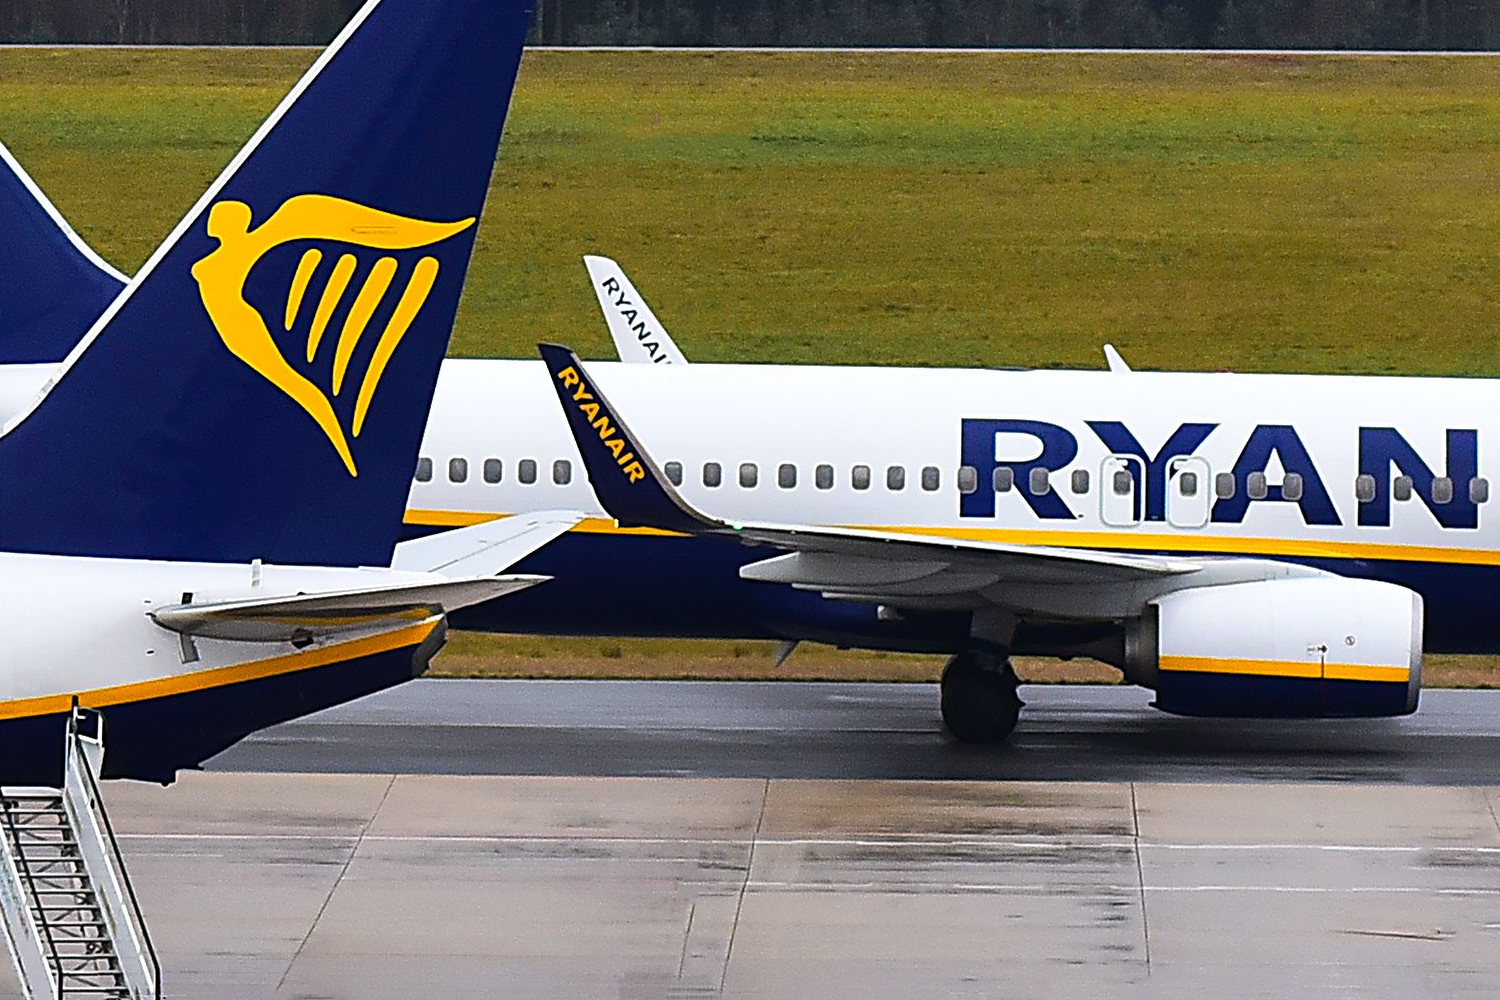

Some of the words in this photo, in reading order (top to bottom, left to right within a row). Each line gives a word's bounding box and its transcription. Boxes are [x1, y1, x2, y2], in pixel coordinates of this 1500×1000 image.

[602, 276, 672, 364] RYANAI
[559, 366, 645, 482] RYANAIR
[957, 418, 1479, 529] RYAN
